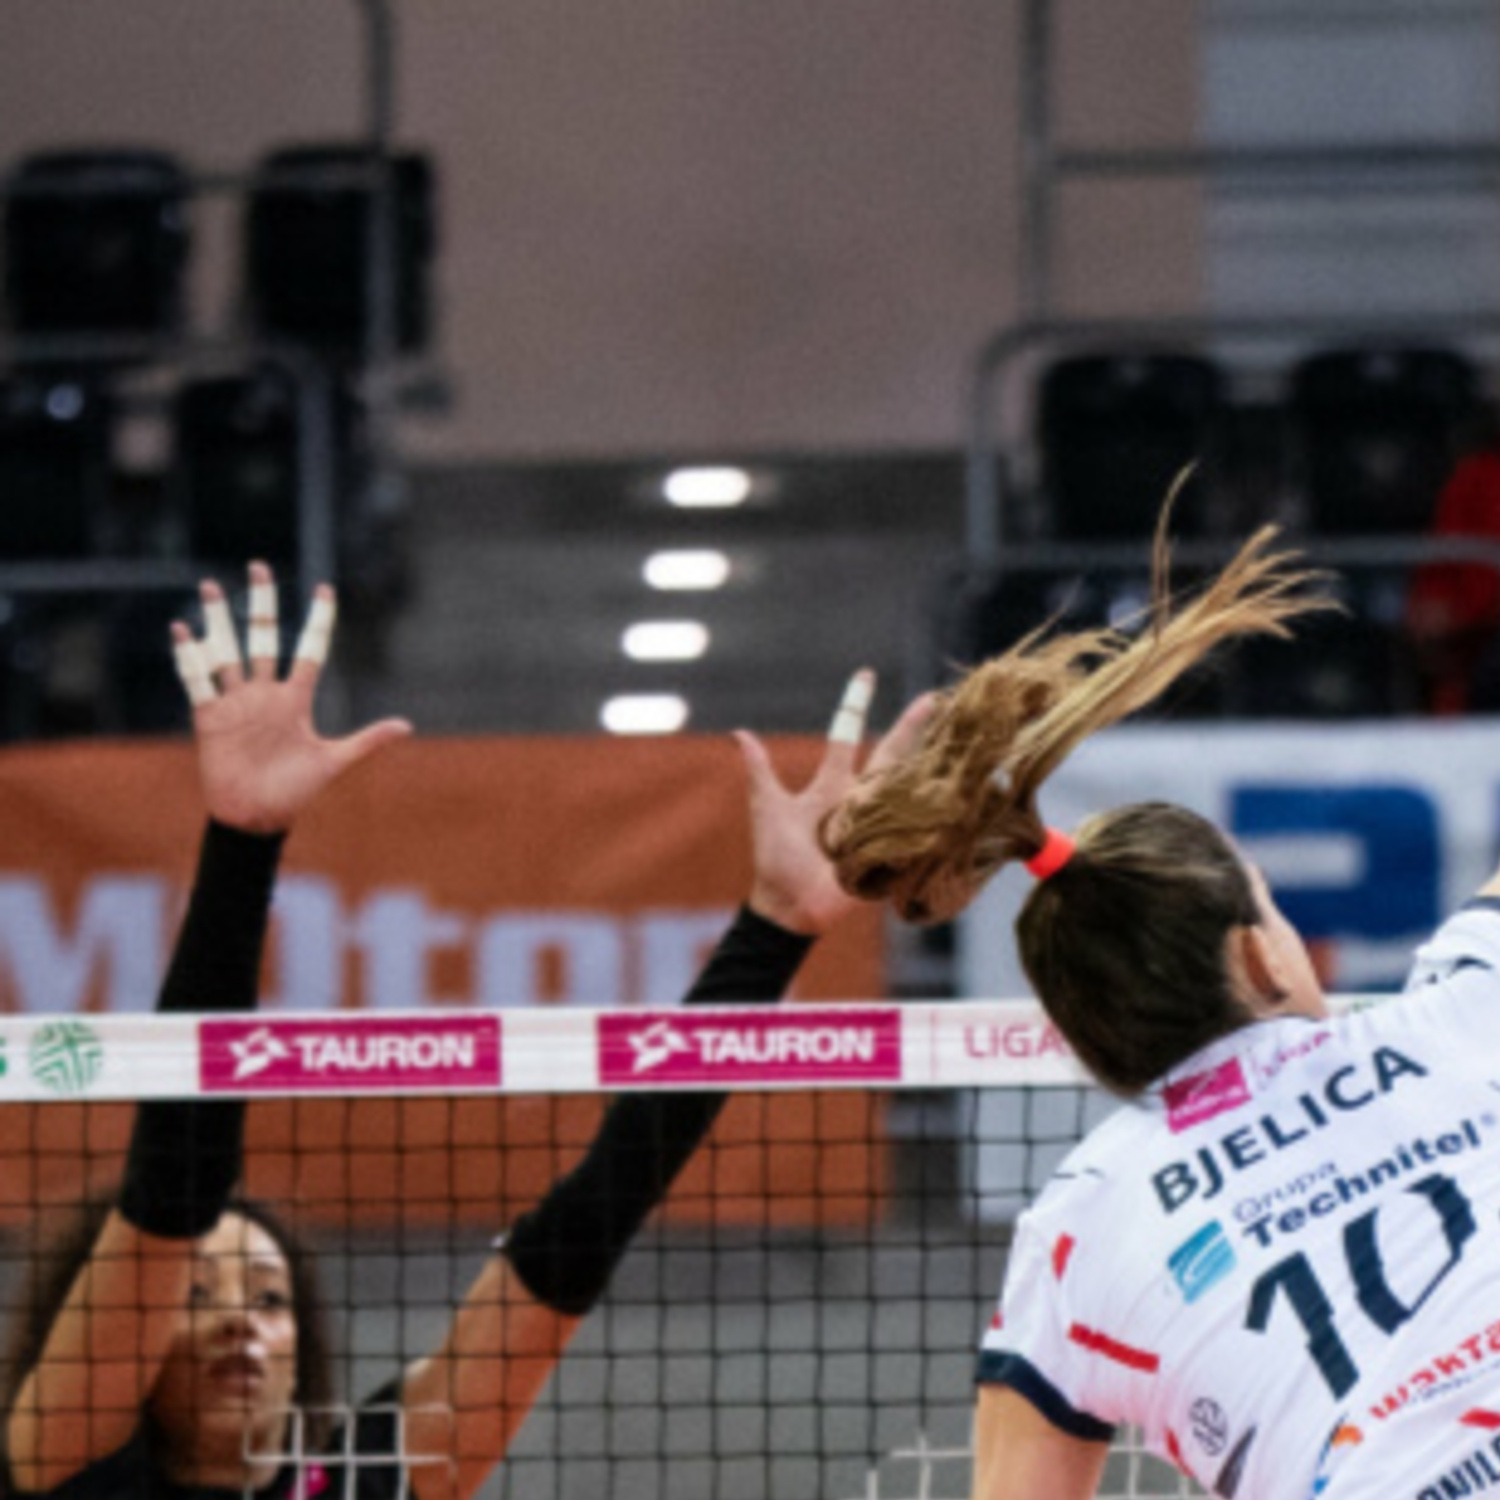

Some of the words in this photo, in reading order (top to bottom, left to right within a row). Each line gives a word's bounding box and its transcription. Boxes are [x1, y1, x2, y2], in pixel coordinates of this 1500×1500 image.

[293, 1032, 475, 1070] TAURON
[693, 1026, 873, 1063] TAURON
[1151, 1044, 1429, 1214] BJELICA
[1232, 1161, 1338, 1222] Grupa
[1243, 1173, 1477, 1402] 10
